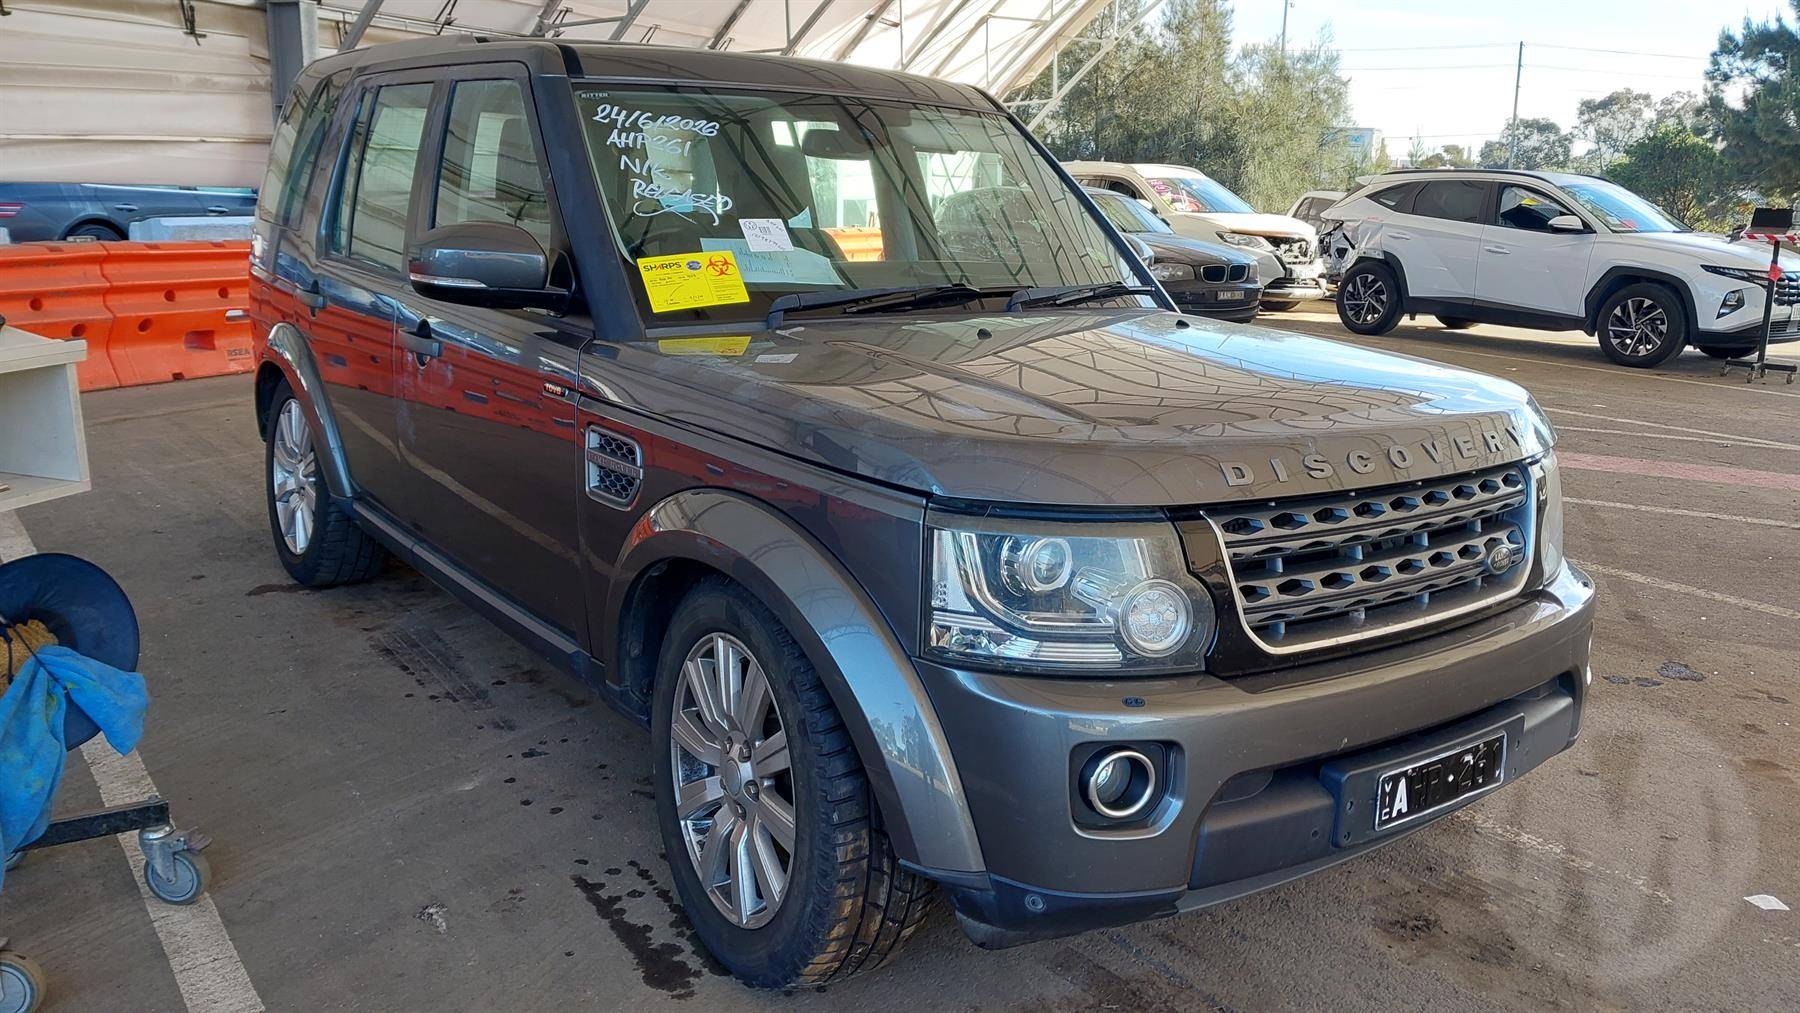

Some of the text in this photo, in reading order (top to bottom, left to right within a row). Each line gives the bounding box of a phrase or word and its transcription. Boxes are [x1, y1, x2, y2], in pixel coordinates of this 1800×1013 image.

[592, 104, 720, 136] 24/6/2026
[643, 261, 682, 272] SHARPS
[1219, 425, 1522, 487] DISCOVERY
